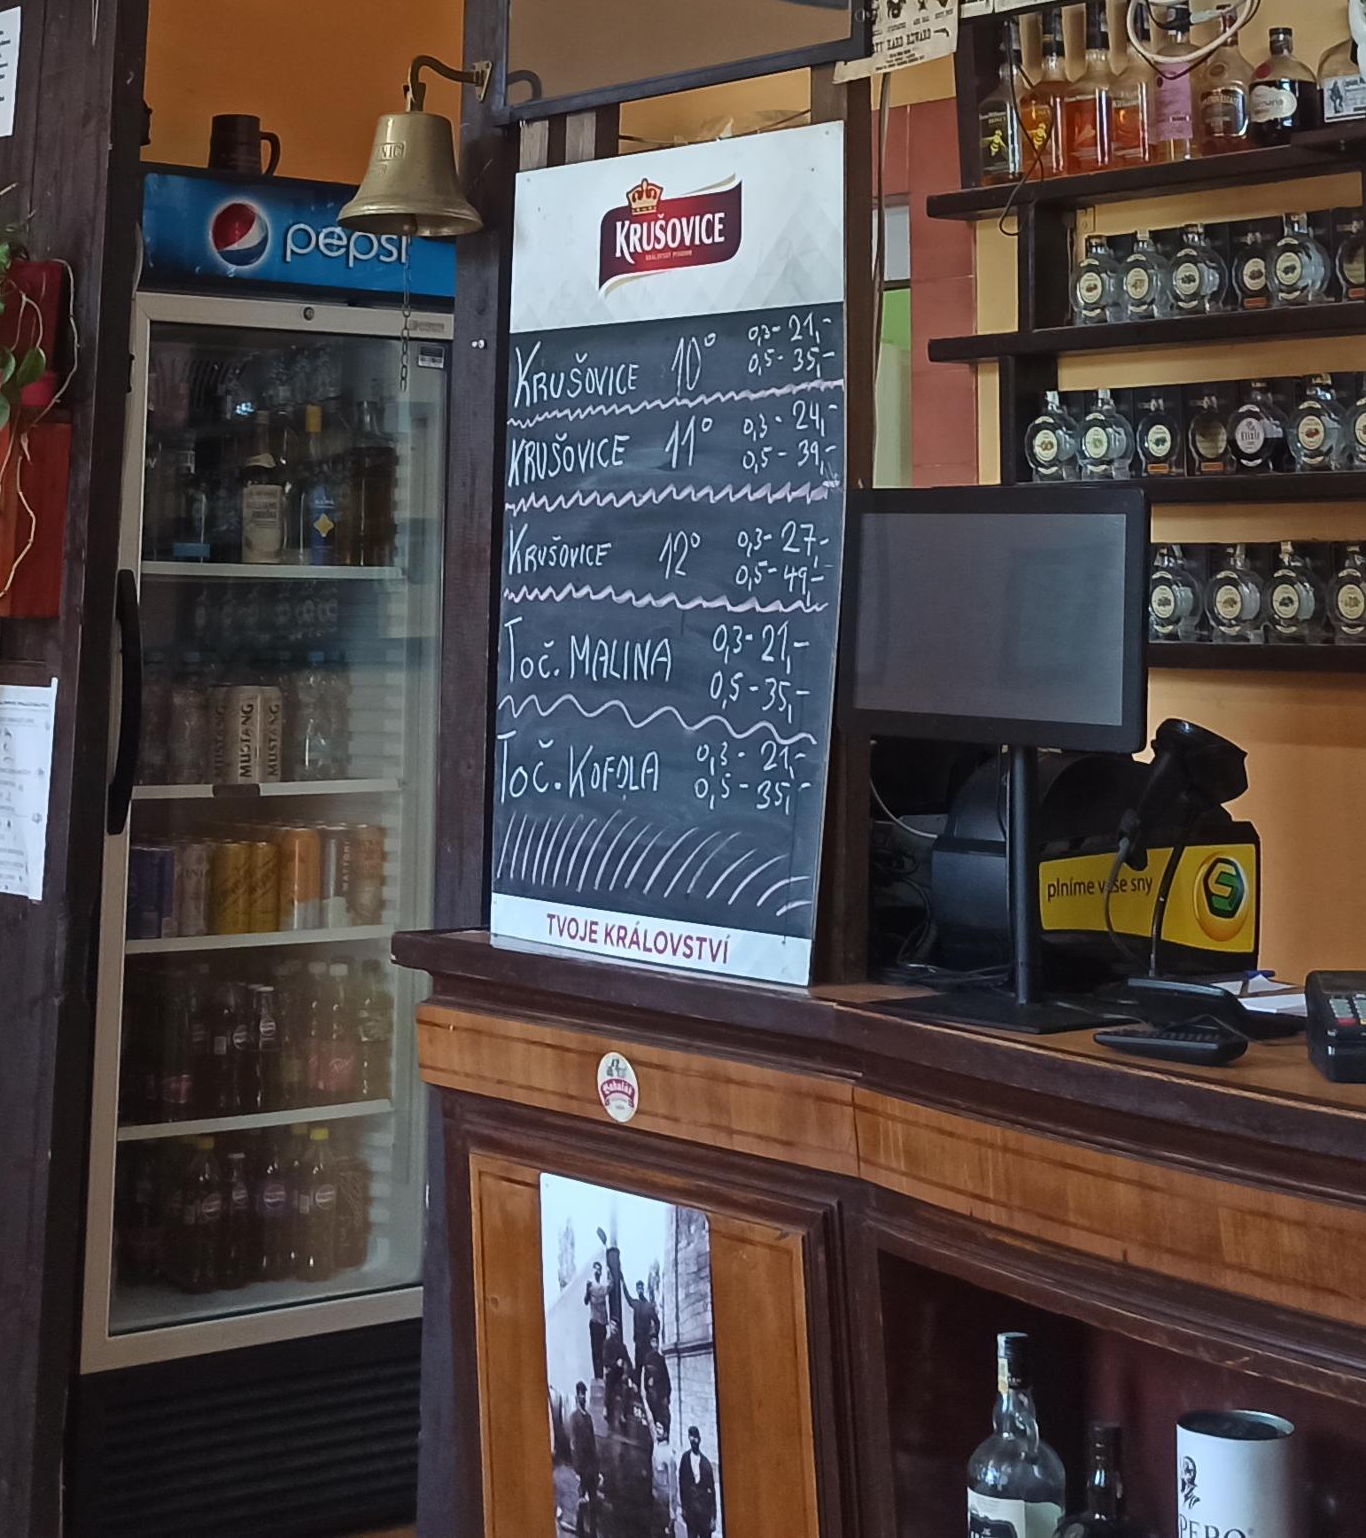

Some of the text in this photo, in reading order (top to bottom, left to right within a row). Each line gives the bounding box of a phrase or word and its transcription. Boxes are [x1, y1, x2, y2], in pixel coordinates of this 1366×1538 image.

[285, 222, 408, 268] pepsi
[616, 212, 725, 264] KRUŠOVICE
[514, 340, 640, 409] KRUŠOVICE
[507, 432, 631, 488] KRUŠOVICE
[507, 523, 613, 577] KRUŠOVICE
[570, 634, 672, 683] MALINA
[239, 702, 255, 779] MUSTANG
[267, 702, 280, 777] MUSTANG
[1047, 877, 1096, 903] plníme
[1130, 877, 1153, 896] sny
[546, 913, 730, 965] TVOJE KRÁLOVSTVÍ
